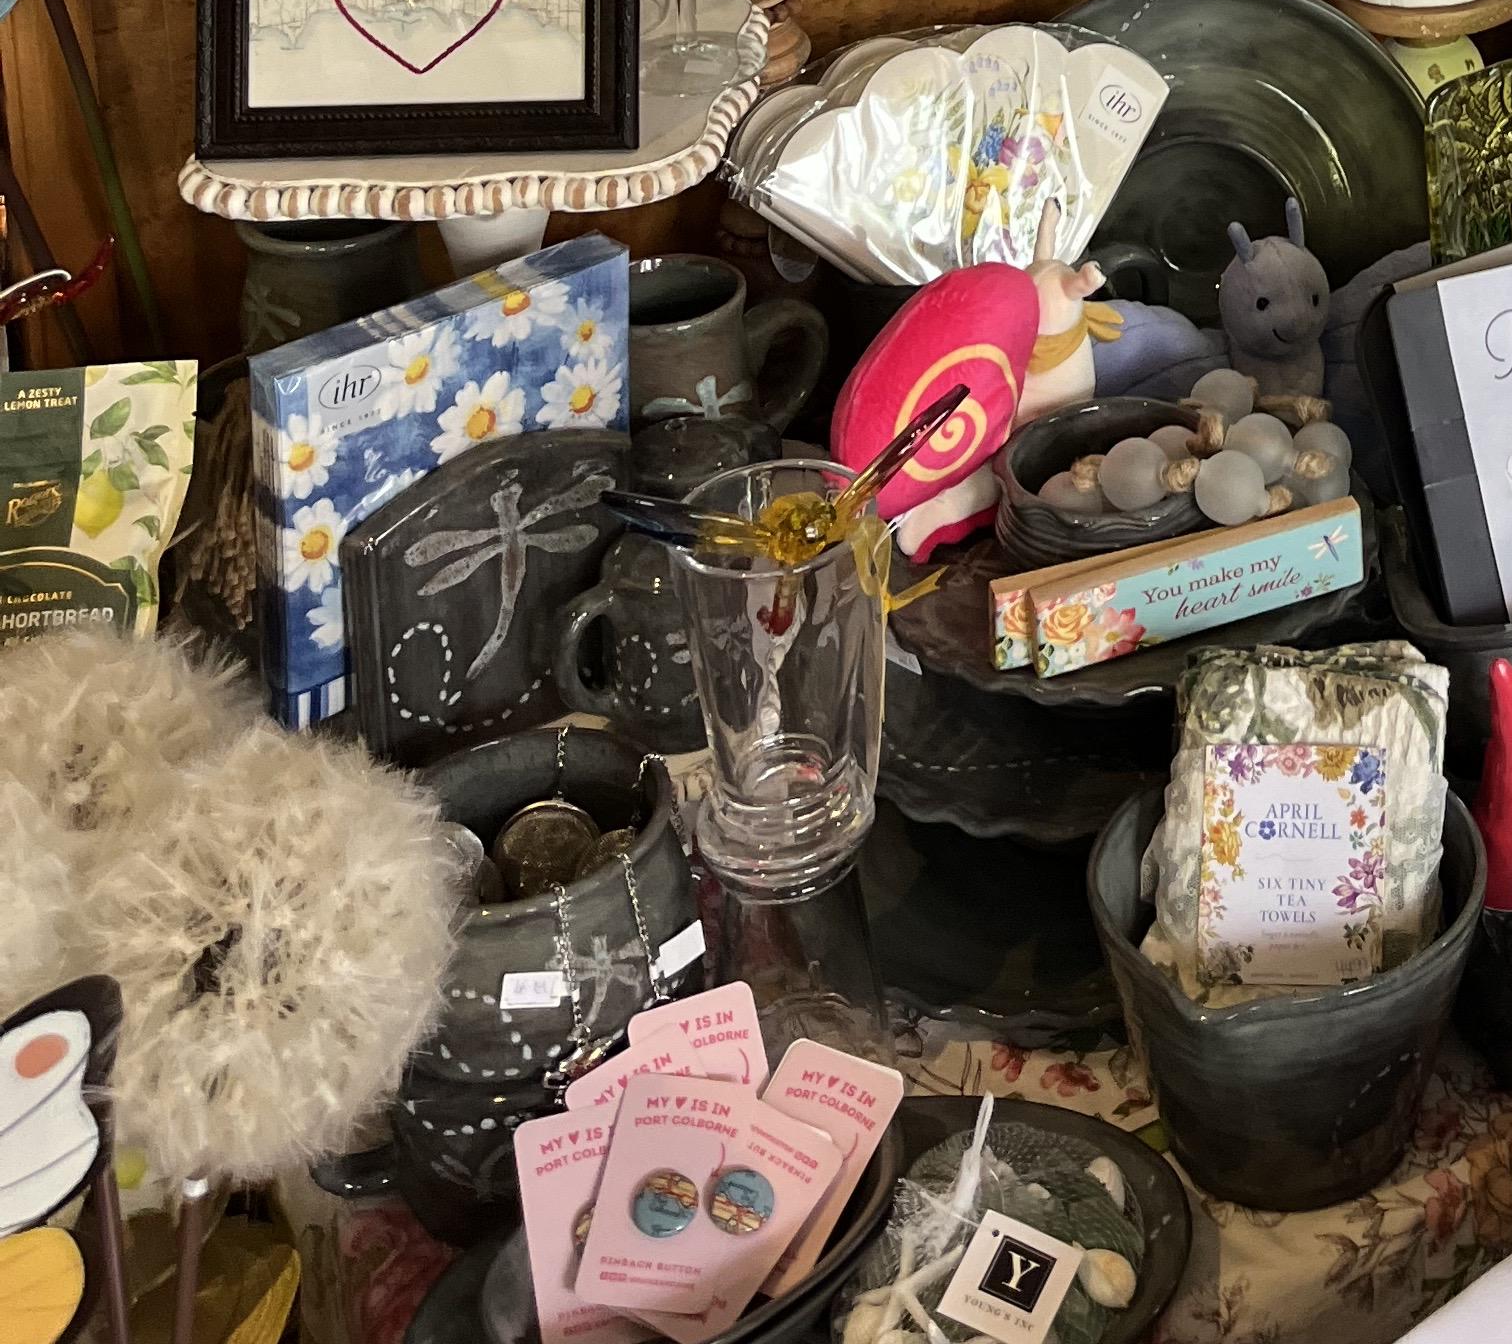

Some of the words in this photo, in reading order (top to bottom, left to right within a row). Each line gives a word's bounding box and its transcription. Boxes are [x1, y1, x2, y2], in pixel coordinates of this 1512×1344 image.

[1105, 89, 1137, 118] ihr
[17, 389, 26, 400] A
[28, 386, 63, 399] ZESTY
[333, 373, 373, 405] ihr
[4, 400, 42, 411] LEMON
[43, 396, 78, 409] TREAT
[1141, 584, 1184, 606] You
[1187, 566, 1245, 594] make
[1249, 553, 1283, 574] my
[1174, 581, 1243, 621] heart
[1246, 566, 1303, 598] smile
[0, 606, 115, 632] HORTBREAD
[1265, 802, 1324, 820] APRIL
[1257, 876, 1283, 891] SIX
[1289, 877, 1328, 892] TINY
[1276, 893, 1308, 907] TEA
[1259, 910, 1318, 924] TOWELS
[695, 1015, 713, 1030] IS
[716, 1010, 735, 1025] IN
[692, 1028, 750, 1049] OLBORNE
[802, 1069, 825, 1087] MY
[840, 1080, 858, 1097] IS
[859, 1092, 877, 1109] IN
[646, 1096, 671, 1110] MY
[690, 1097, 709, 1112] IS
[711, 1101, 732, 1118] IN
[785, 1086, 818, 1105] PORT
[818, 1094, 876, 1132] COLBORNE
[634, 1115, 671, 1129] PORT
[672, 1115, 740, 1139] COLBORNE
[540, 1135, 564, 1156] MY
[585, 1126, 604, 1141] IS
[535, 1155, 570, 1177] PORT
[1001, 1250, 1041, 1293] Y
